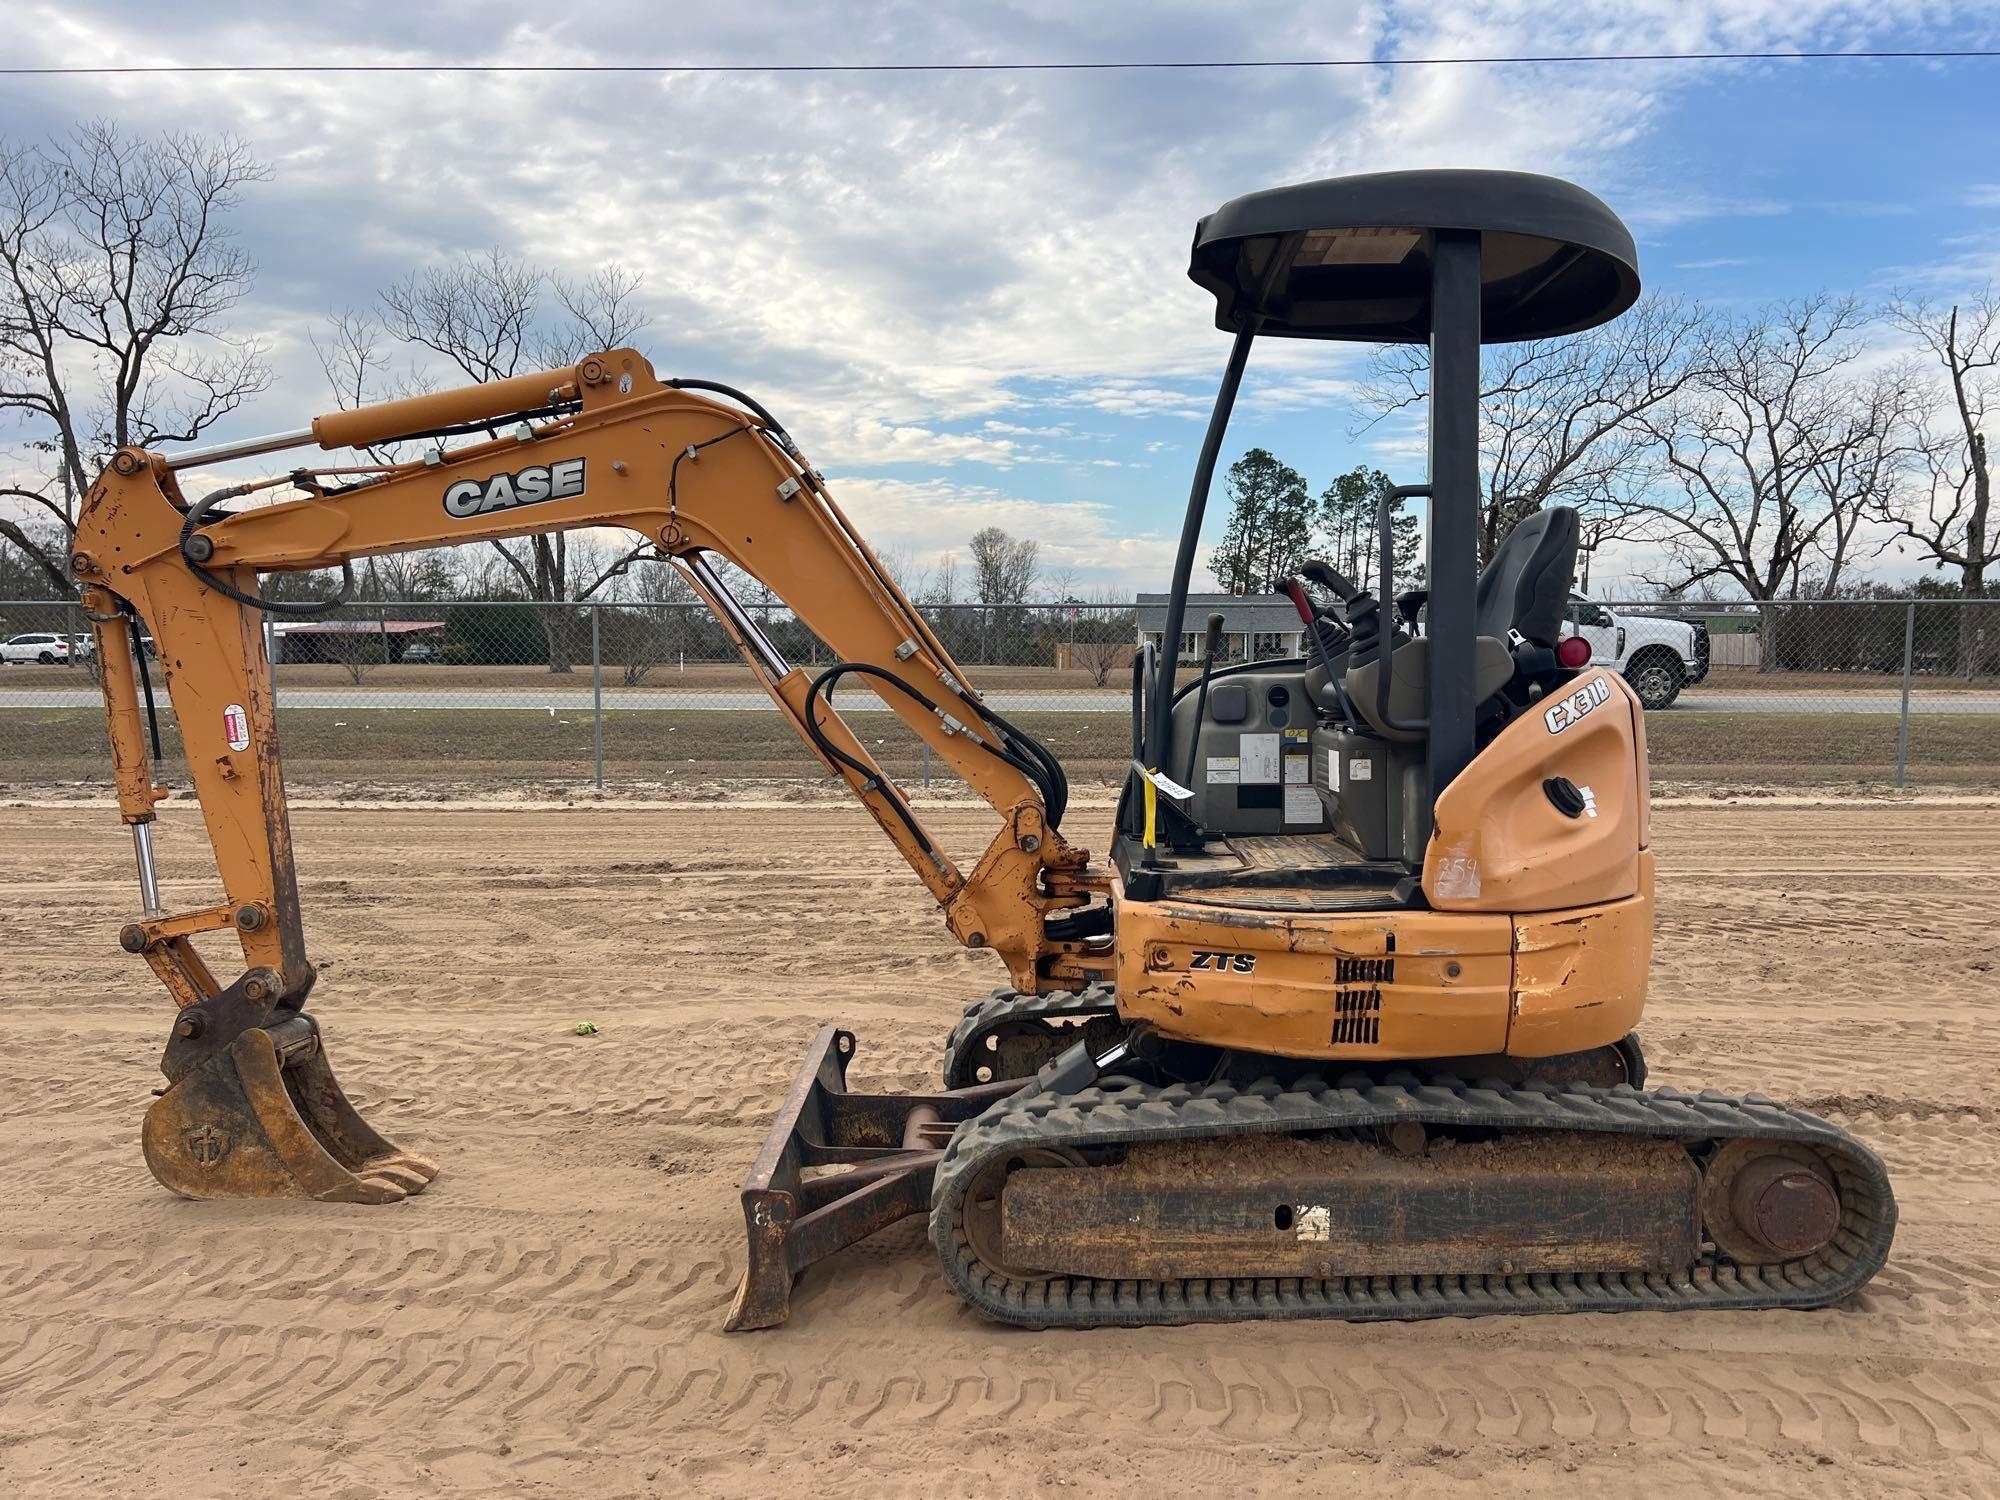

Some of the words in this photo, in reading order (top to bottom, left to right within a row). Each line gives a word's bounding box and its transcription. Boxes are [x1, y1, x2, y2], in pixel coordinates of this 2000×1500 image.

[444, 459, 585, 517] CASE
[1544, 676, 1610, 734] CX31B
[1189, 951, 1256, 974] ZTS
